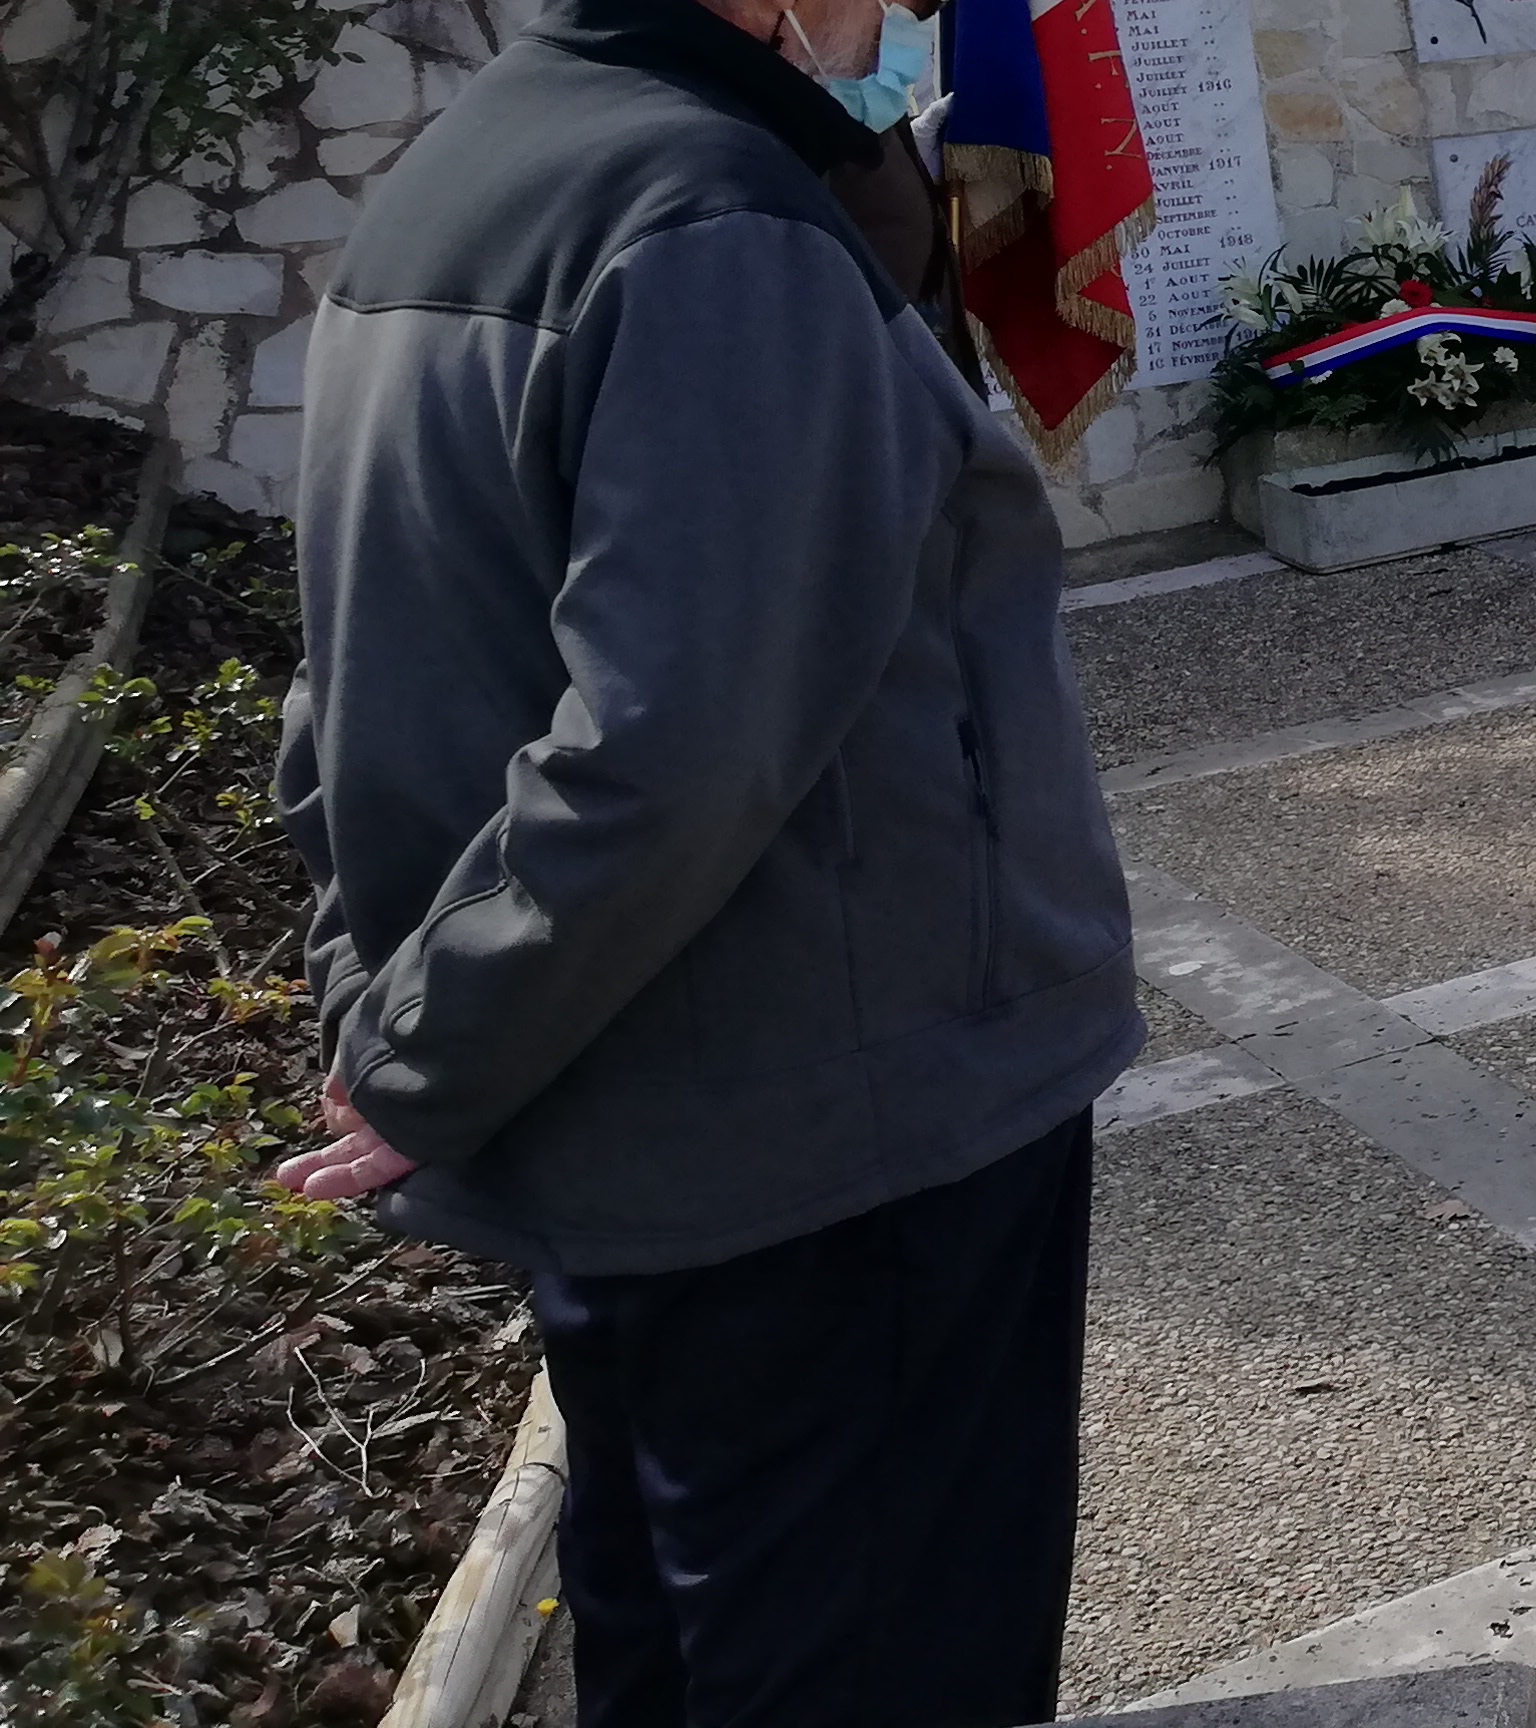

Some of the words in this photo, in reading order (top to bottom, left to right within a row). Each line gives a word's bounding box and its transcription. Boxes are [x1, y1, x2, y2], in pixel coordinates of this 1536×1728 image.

[1126, 10, 1157, 22] MAI
[1128, 25, 1160, 38] MAI
[1131, 38, 1189, 52] JUILLET
[1134, 54, 1185, 68] JUILLET
[1136, 69, 1188, 83] JUILLET
[1138, 84, 1188, 99] JUILLET
[1198, 78, 1233, 93] 1916
[1141, 101, 1180, 115] AOUT
[1143, 117, 1182, 131] AOUT
[1145, 133, 1185, 147] AOUT
[1150, 162, 1200, 177] JANVIER
[1208, 156, 1242, 171] 1917
[1154, 194, 1204, 208] JUILLET
[1158, 225, 1211, 241] OCTOBRE
[1160, 244, 1191, 257] MAI
[1219, 233, 1254, 249] 1918
[1134, 263, 1155, 276] 24
[1162, 257, 1211, 272] JUILLET
[1166, 273, 1210, 288] AOUT
[1138, 294, 1158, 307] 22
[1168, 289, 1212, 303] AOUT
[1145, 326, 1162, 339] 31
[1148, 339, 1162, 355] 17
[1172, 335, 1226, 352] NOVEMBR
[1236, 327, 1260, 342] 191
[1149, 358, 1165, 371] 16
[1171, 351, 1221, 368] FÉVRIER
